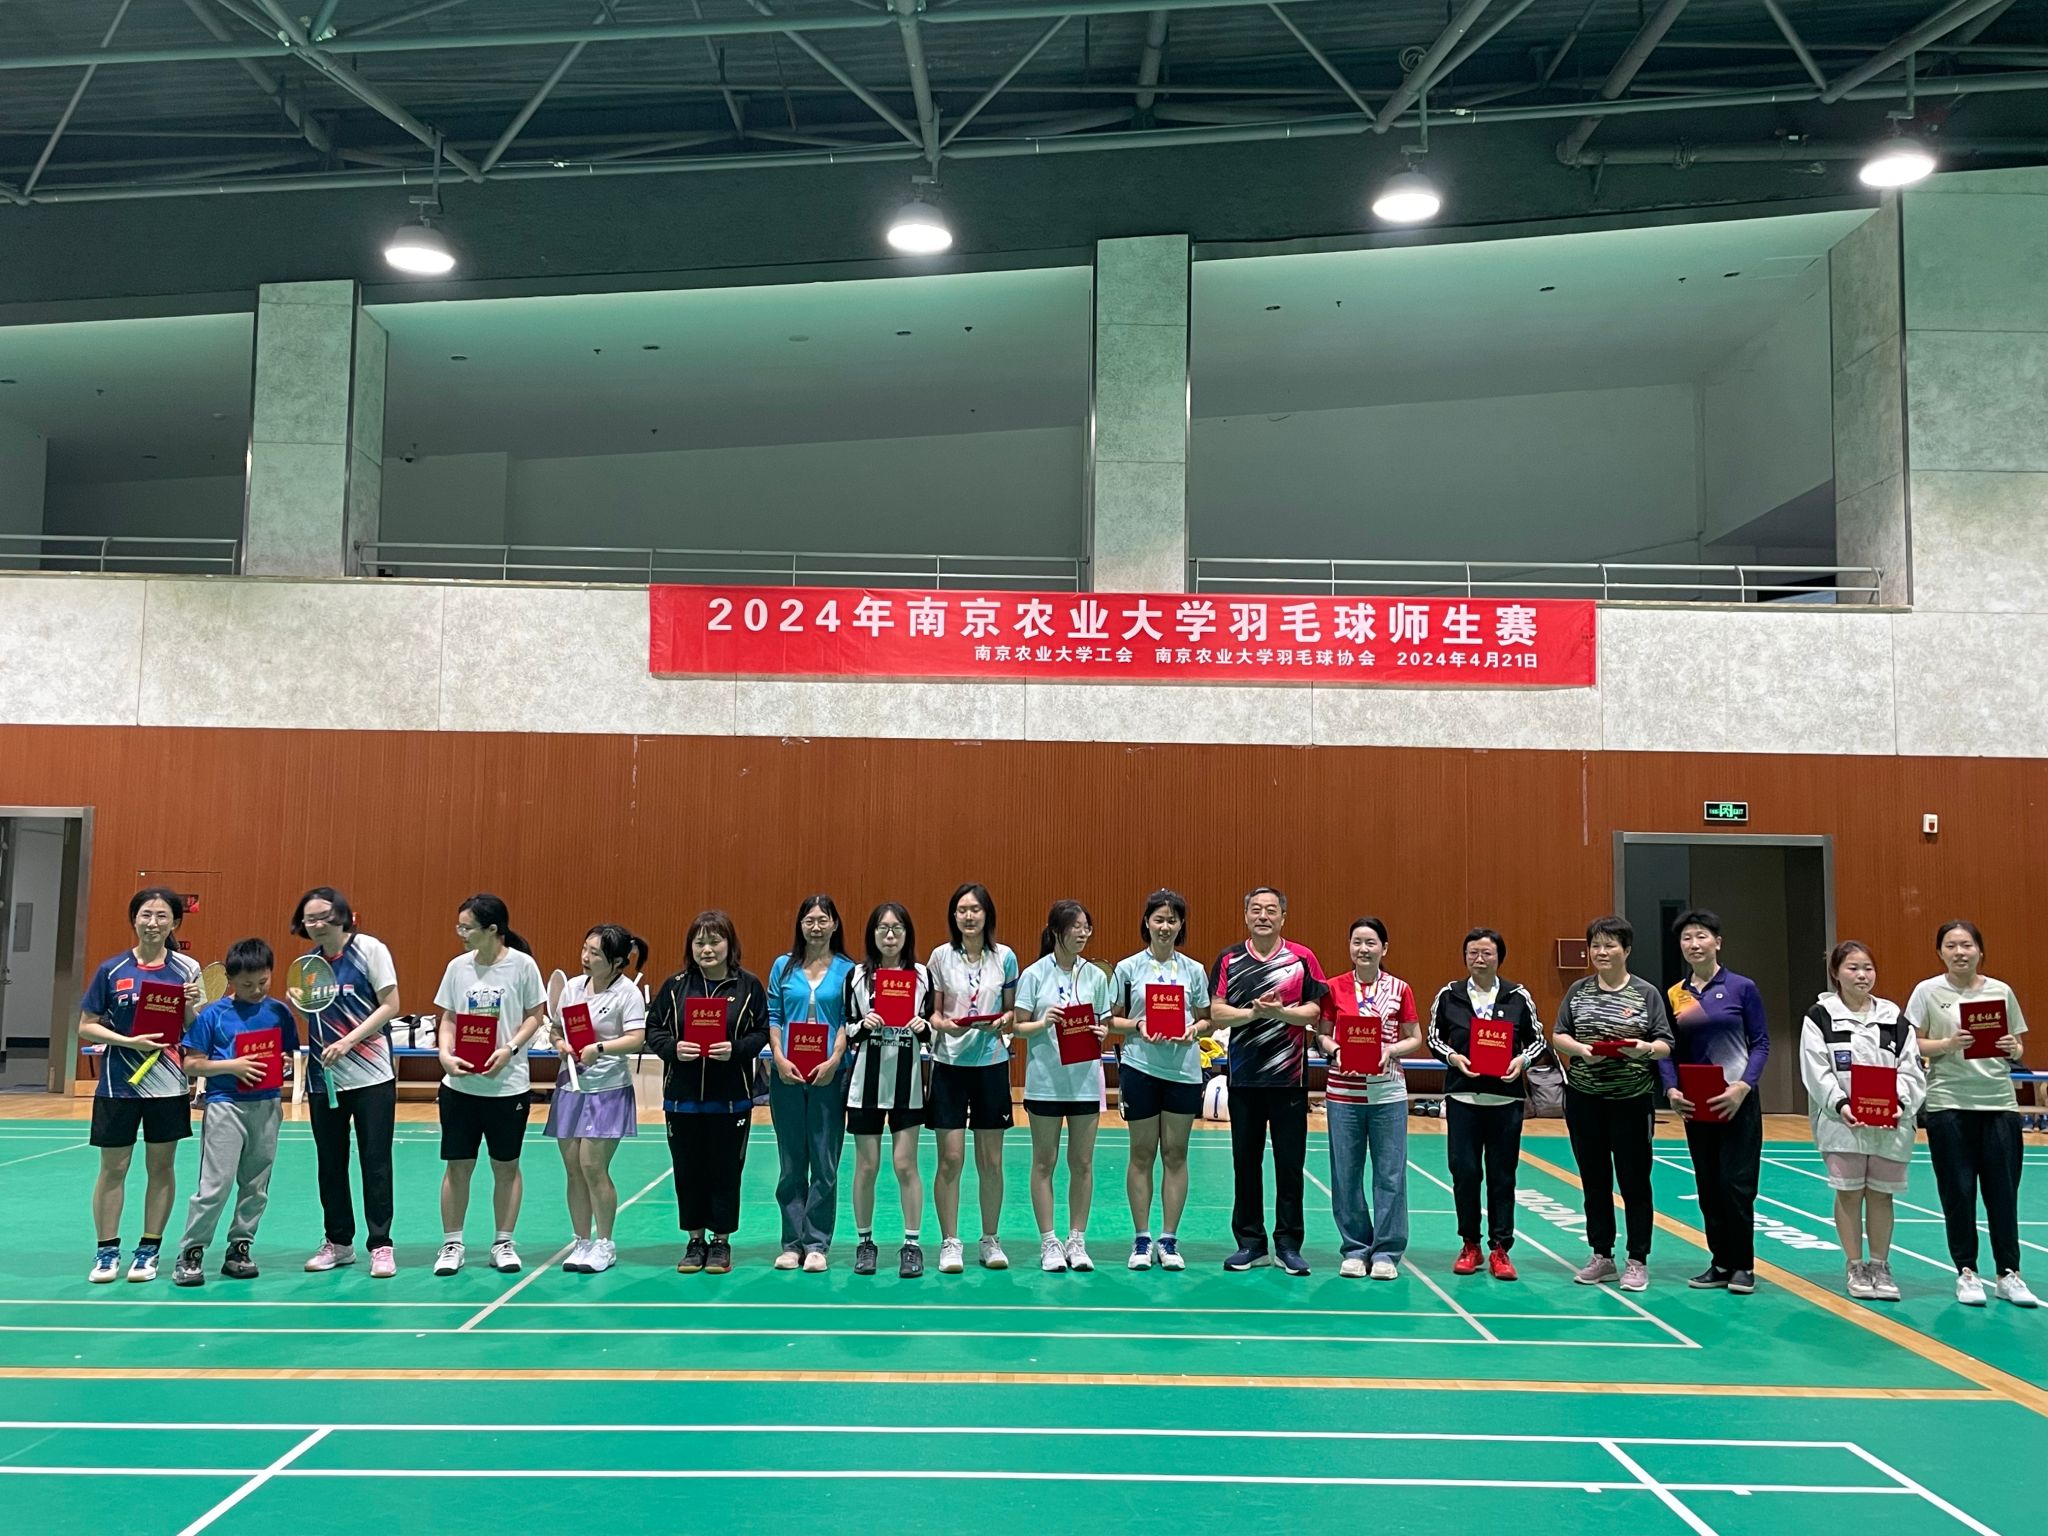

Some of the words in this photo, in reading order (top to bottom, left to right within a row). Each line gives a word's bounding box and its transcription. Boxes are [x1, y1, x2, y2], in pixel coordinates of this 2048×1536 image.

[707, 596, 1538, 646] 2024年南京农业大学羽毛球师生赛
[974, 644, 1133, 664] 南京农业大学工会
[1155, 647, 1376, 667] 南京农业大学羽毛球协会
[1397, 651, 1538, 669] 2024年4月21日
[881, 979, 911, 989] 荣誉证书
[311, 984, 354, 1000] HINA
[145, 993, 180, 1005] 荣誉证书
[1151, 993, 1181, 1003] 荣誉证书
[691, 1009, 722, 1018] 荣誉证书
[461, 1025, 491, 1036] 荣誉证书
[1347, 1026, 1377, 1036] 荣誉证书
[1477, 1029, 1507, 1040] 荣誉证书
[793, 1034, 823, 1044] 荣誉证书
